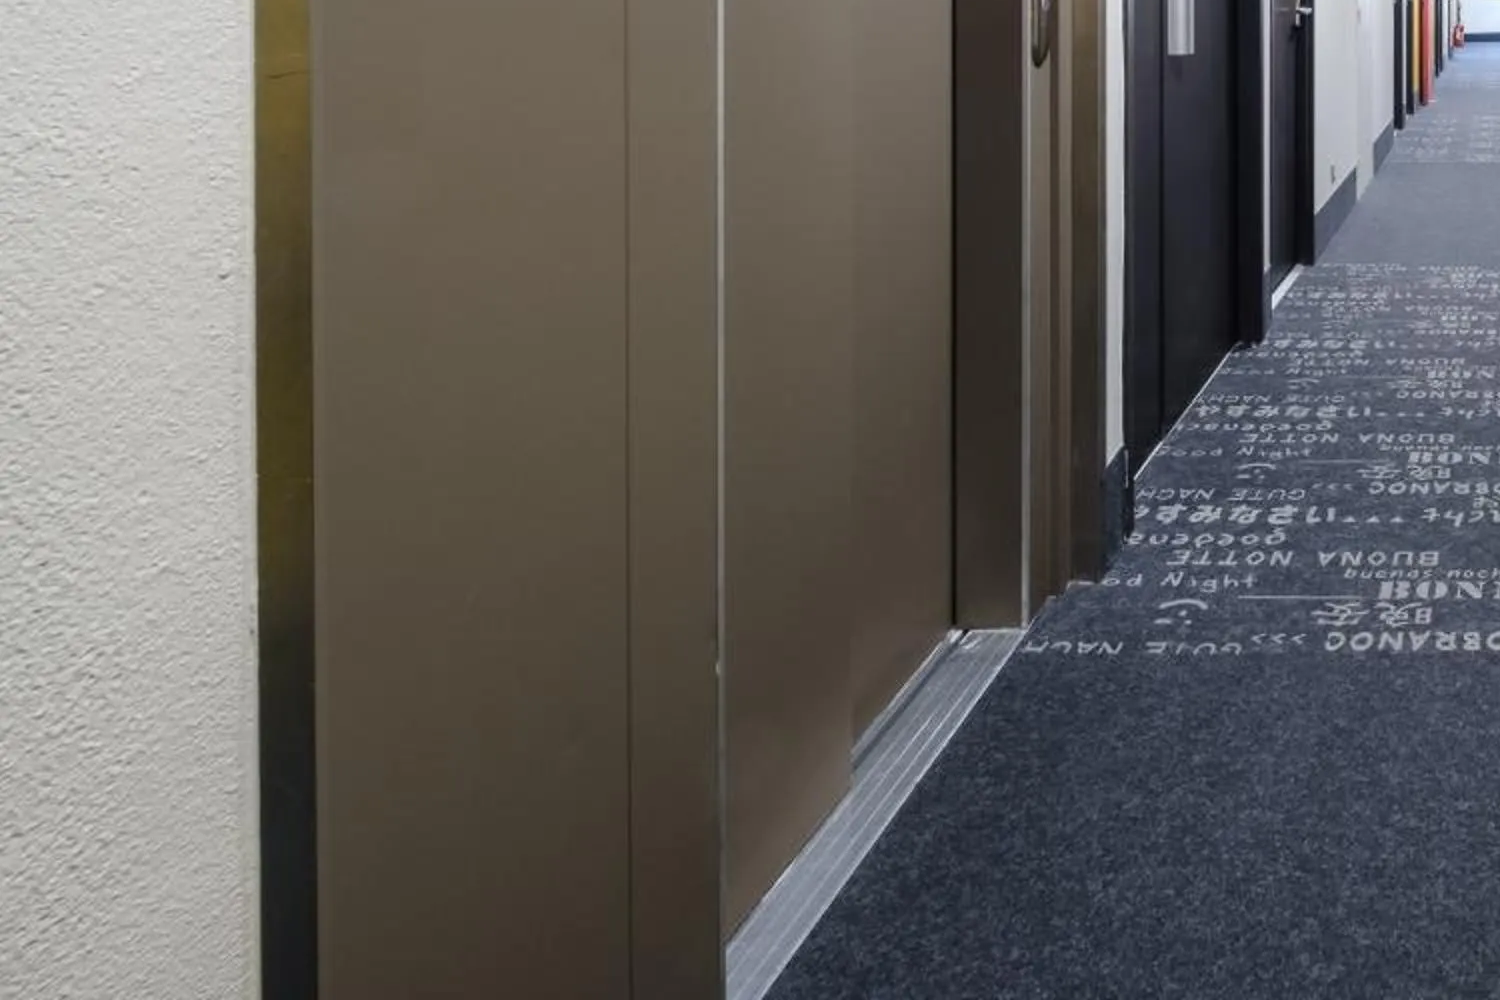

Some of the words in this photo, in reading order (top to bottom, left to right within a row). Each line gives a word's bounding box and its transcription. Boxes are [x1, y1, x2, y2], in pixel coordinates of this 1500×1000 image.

[1167, 551, 1294, 567] NOTTE
[1318, 551, 1440, 567] BUONA
[1160, 571, 1258, 593] Night
